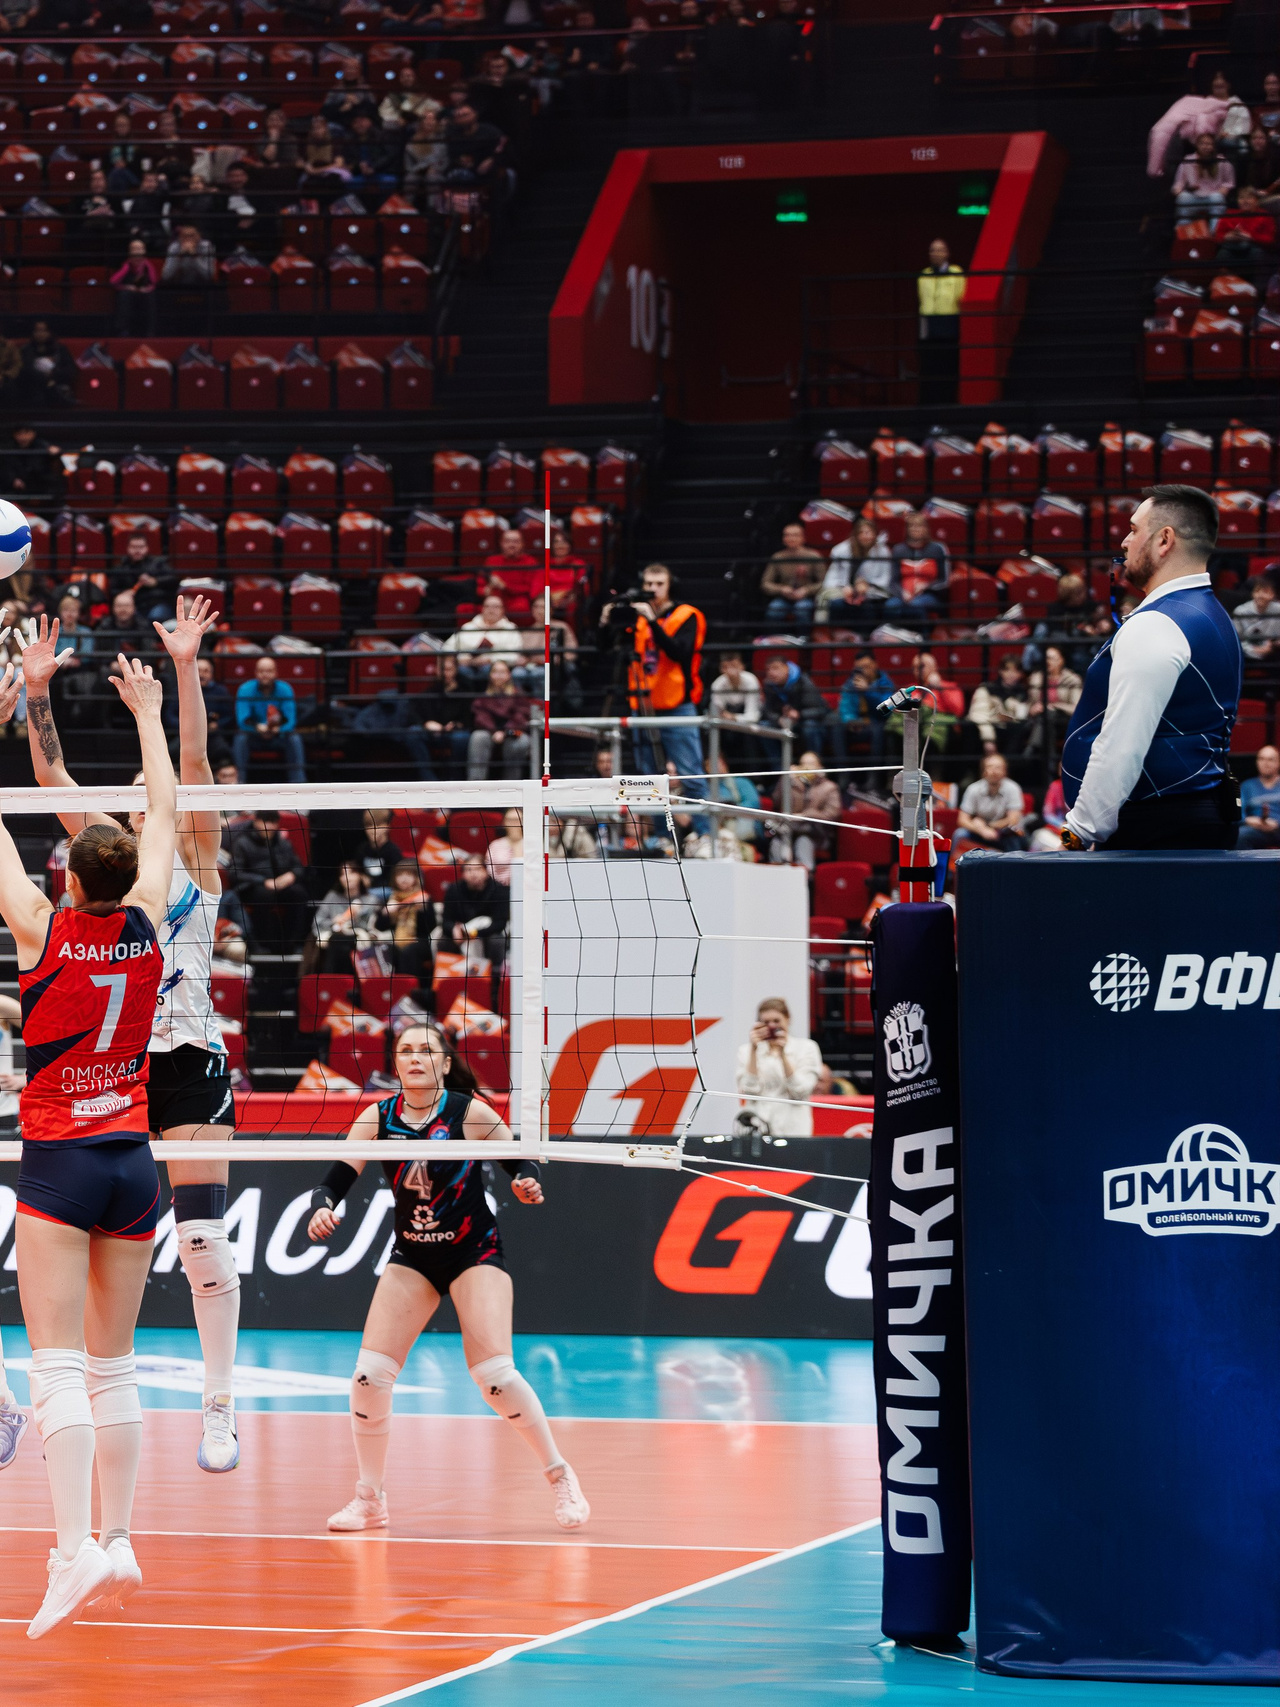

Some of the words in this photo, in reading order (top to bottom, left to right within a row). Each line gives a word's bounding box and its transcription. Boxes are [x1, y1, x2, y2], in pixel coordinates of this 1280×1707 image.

[627, 779, 655, 787] Senoh
[58, 939, 154, 962] АЗАНОВА
[89, 973, 127, 1053] 7
[62, 1058, 137, 1081] ОМСКАЯ
[886, 1093, 912, 1108] ОМСКОЙ
[911, 1086, 942, 1101] ОБЛАСТИ
[887, 1077, 938, 1098] ПРАВИТЕЛЬСТВО
[1155, 1211, 1234, 1224] ВОЛЕЙБОЛЬНЫЙ
[1235, 1212, 1261, 1223] КЛУБ
[403, 1230, 456, 1243] ФОСАГРО
[885, 1125, 955, 1555] ОМИЧКА
